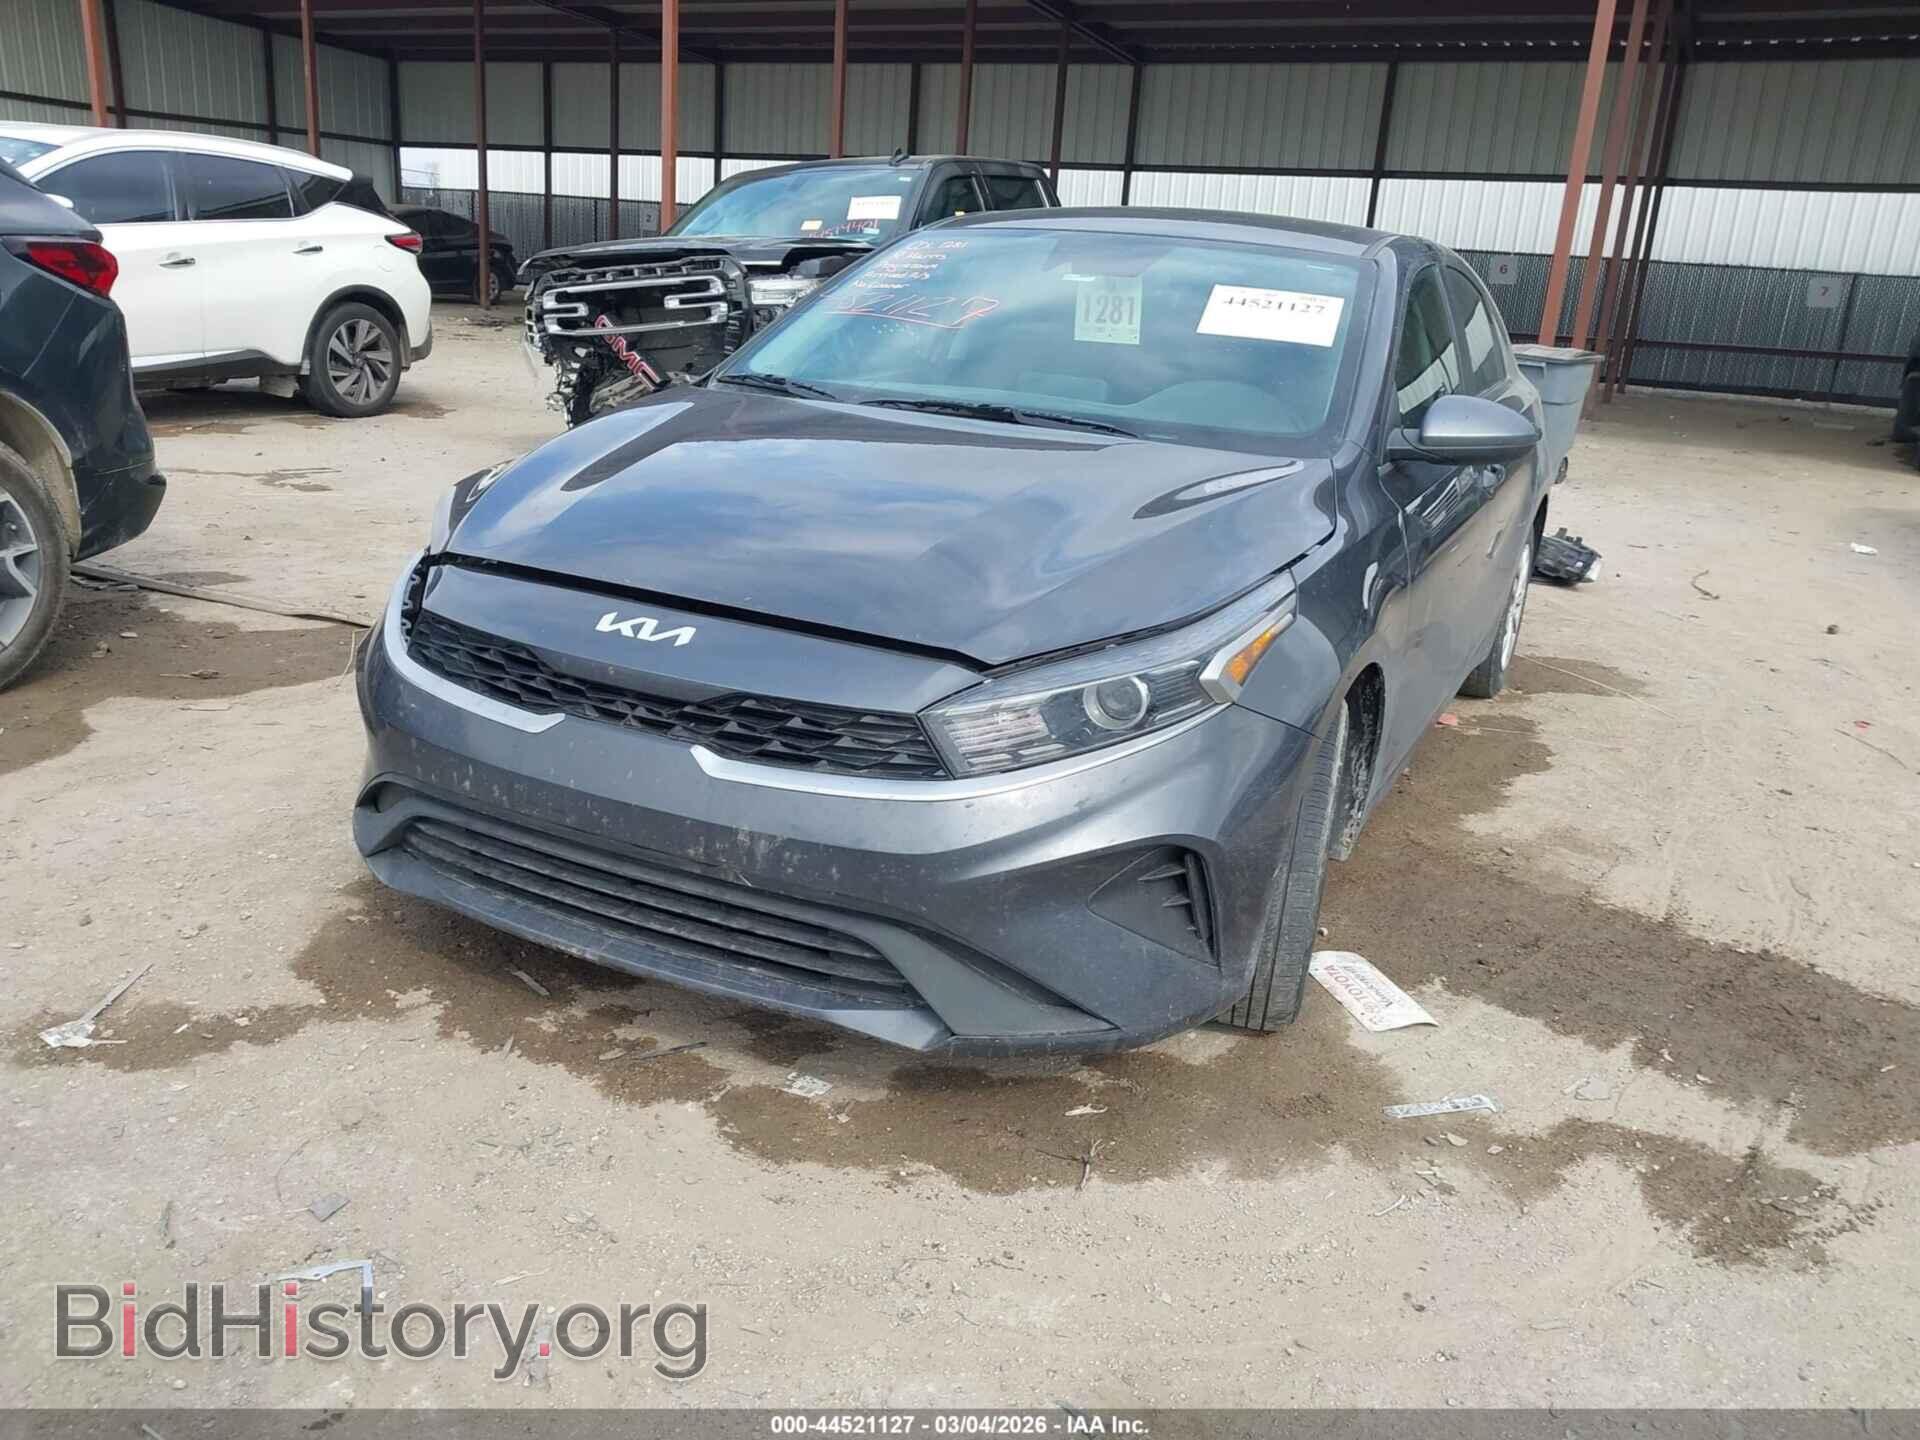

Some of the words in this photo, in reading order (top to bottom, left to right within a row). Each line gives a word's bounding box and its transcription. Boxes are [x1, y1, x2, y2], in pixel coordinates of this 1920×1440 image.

[1499, 263, 1509, 274] 6
[1820, 286, 1830, 297] 7
[1083, 295, 1136, 326] 1281
[1323, 965, 1368, 1001] TOYOTA
